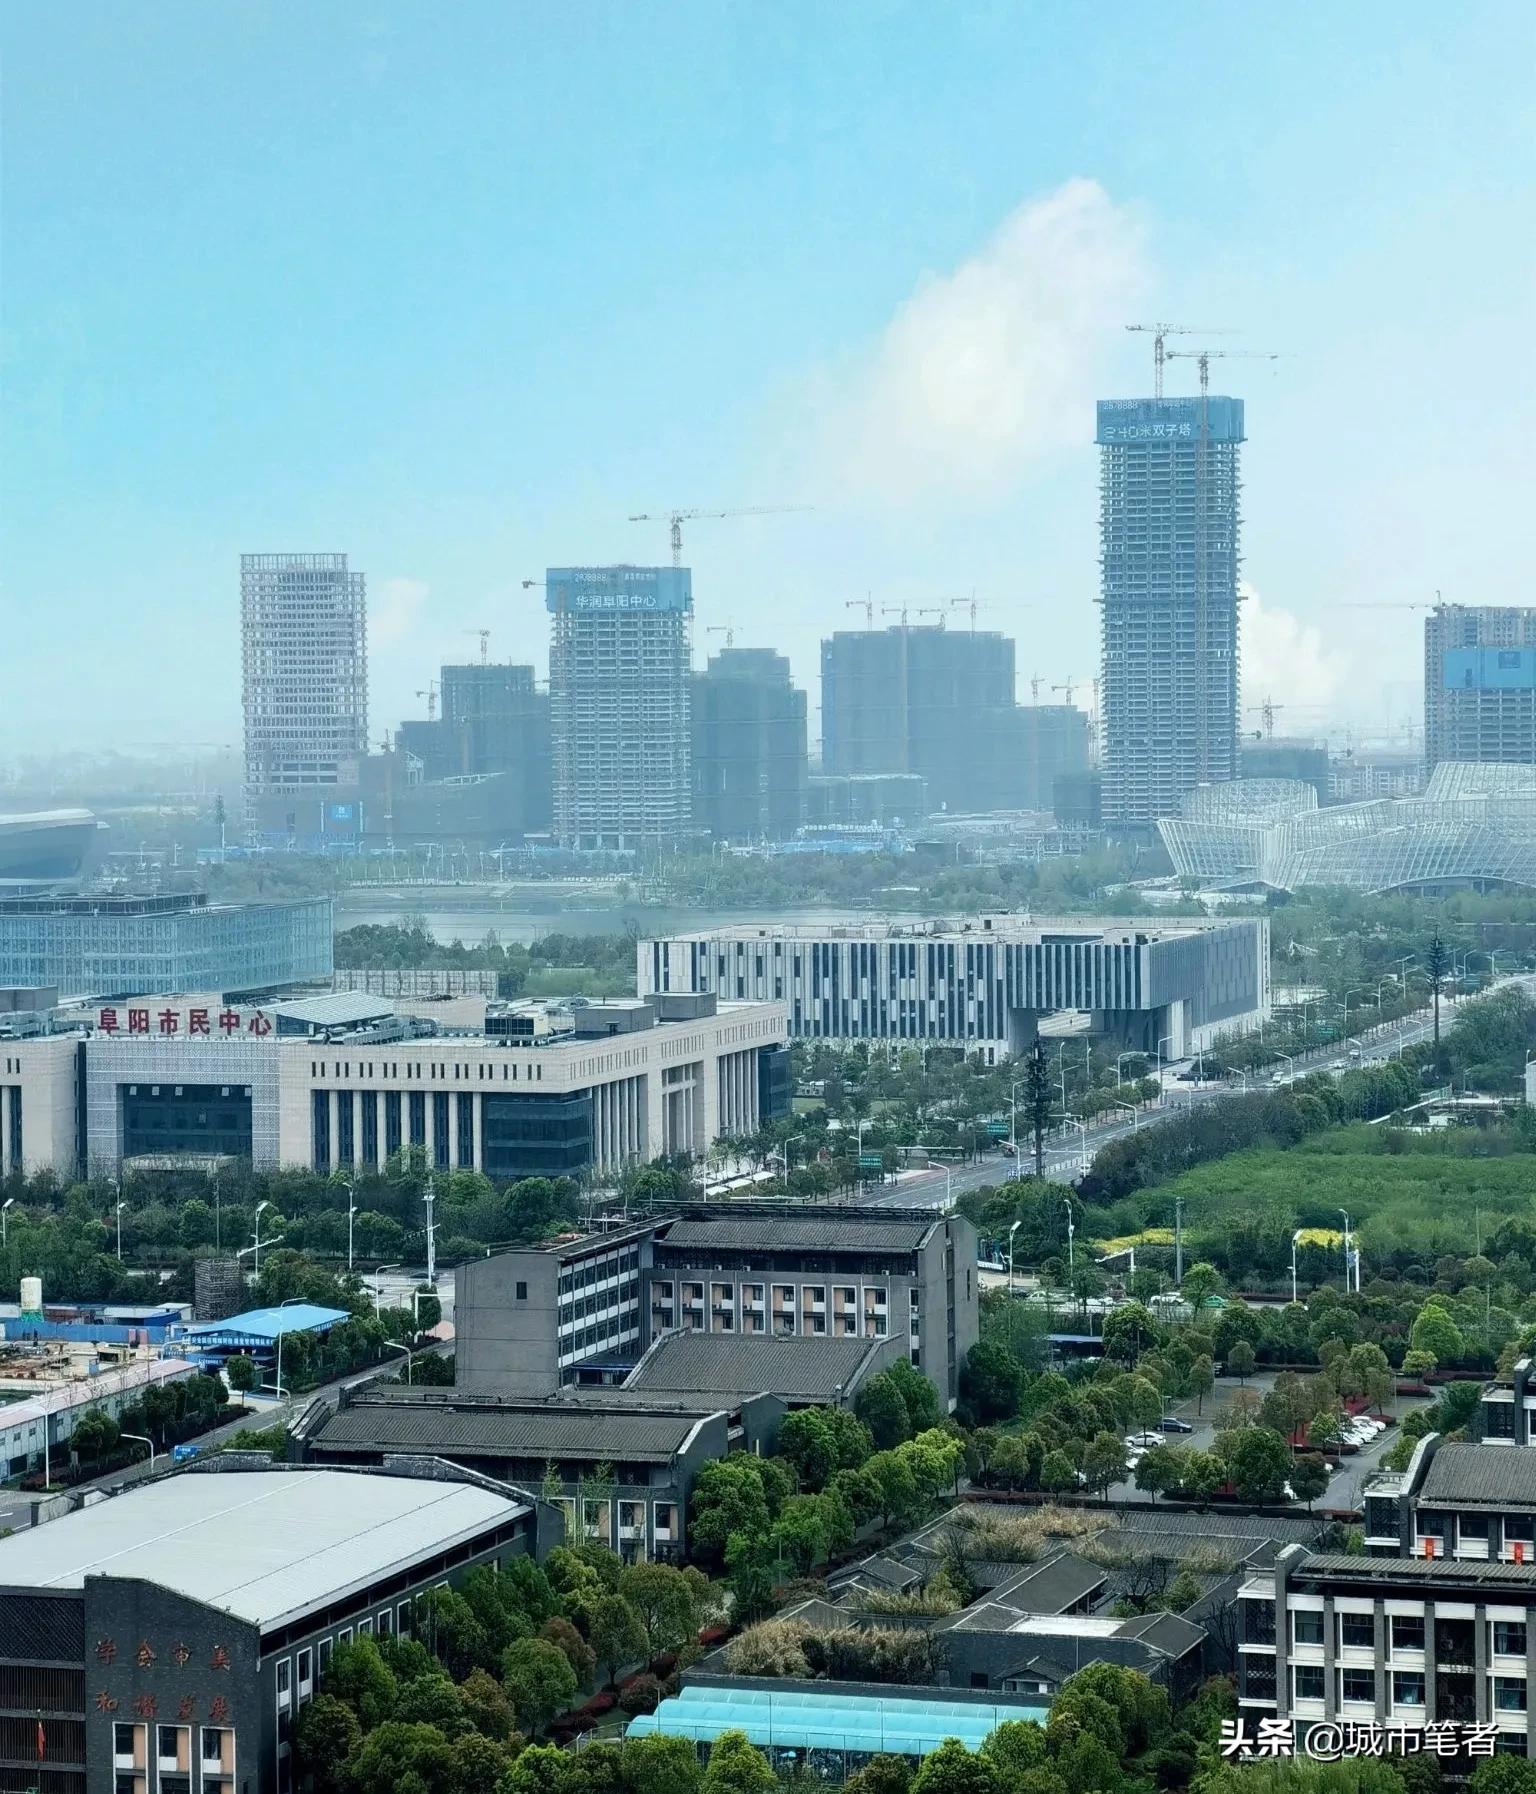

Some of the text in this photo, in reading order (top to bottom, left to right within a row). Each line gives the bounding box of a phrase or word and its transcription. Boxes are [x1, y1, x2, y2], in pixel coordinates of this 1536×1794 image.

[1104, 423, 1192, 439] 240米双子塔
[576, 594, 656, 608] 华润阜阳中心
[98, 1007, 272, 1037] 阜阳市民中心
